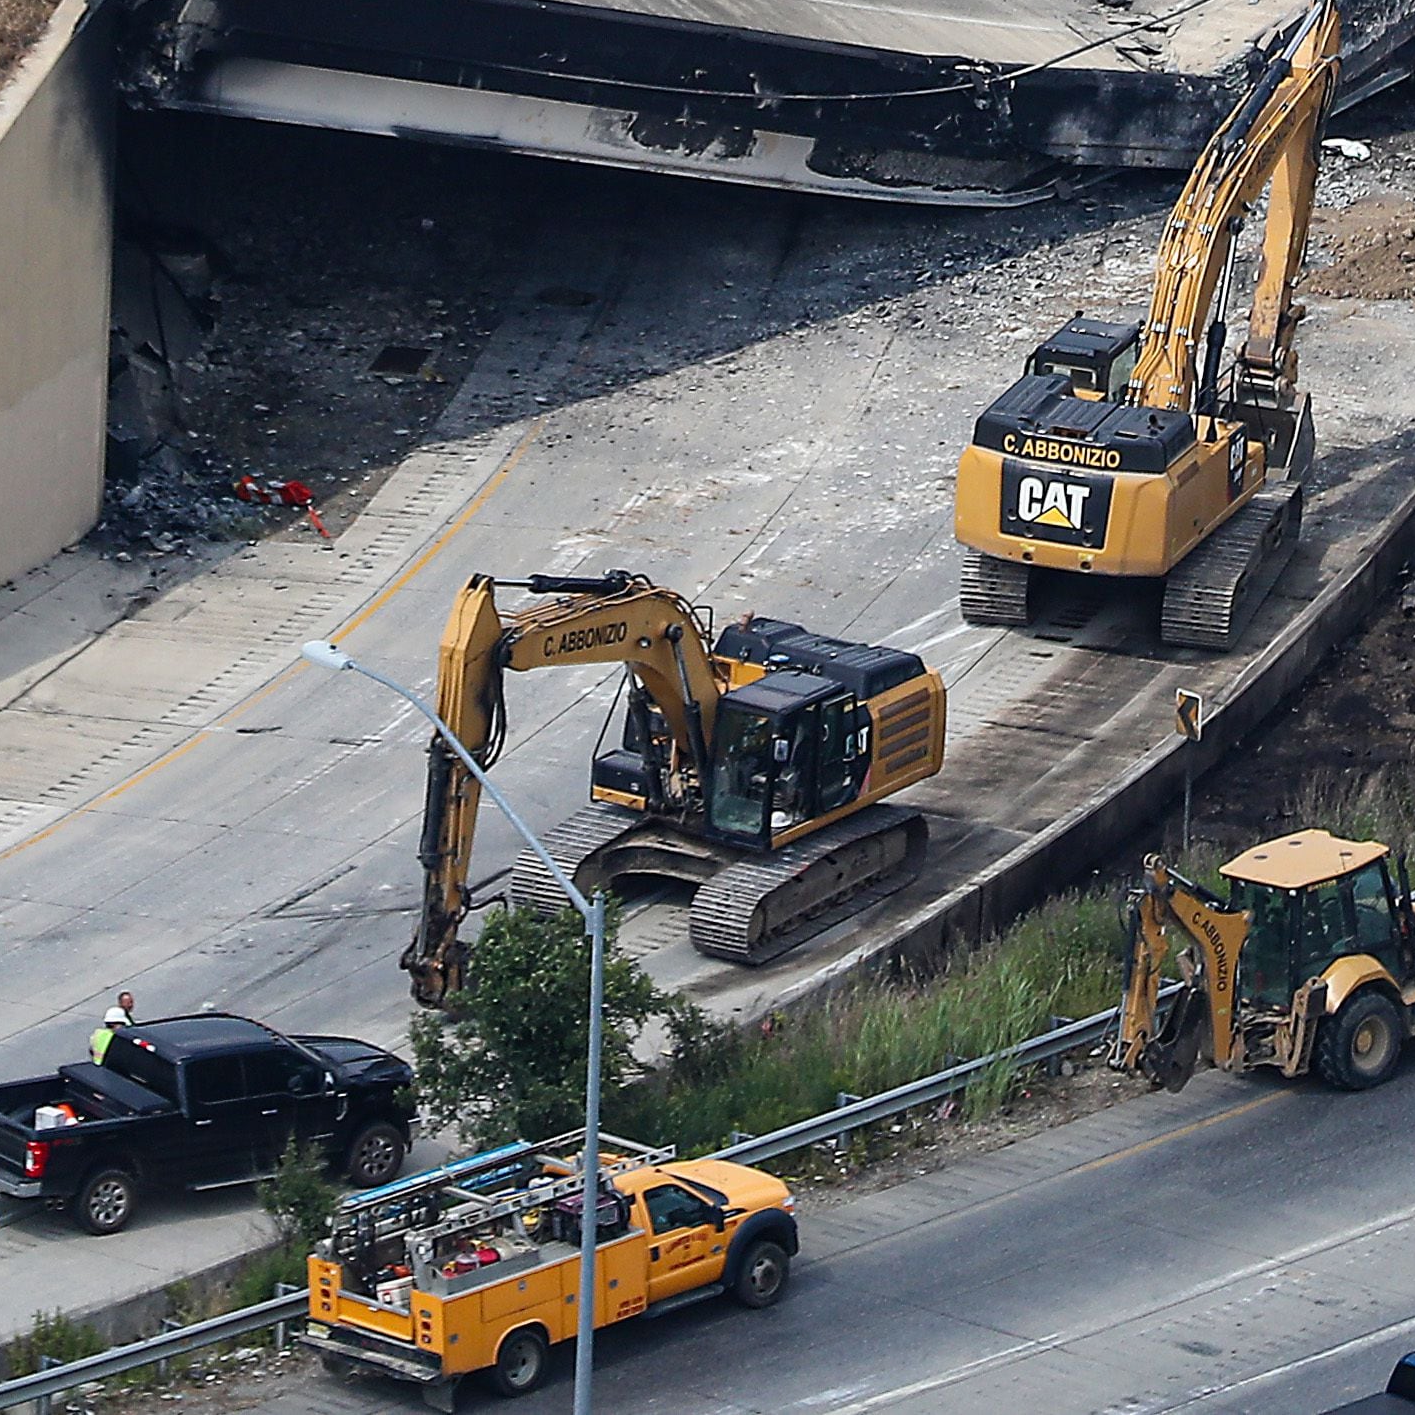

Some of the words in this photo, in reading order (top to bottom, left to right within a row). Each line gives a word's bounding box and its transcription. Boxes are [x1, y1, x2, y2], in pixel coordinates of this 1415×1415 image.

[1003, 433, 1019, 454] C.
[1021, 438, 1121, 468] ABBONIZIO
[1018, 476, 1091, 530] CAT
[543, 635, 557, 657] C.
[558, 621, 627, 654] ABBONIZIO
